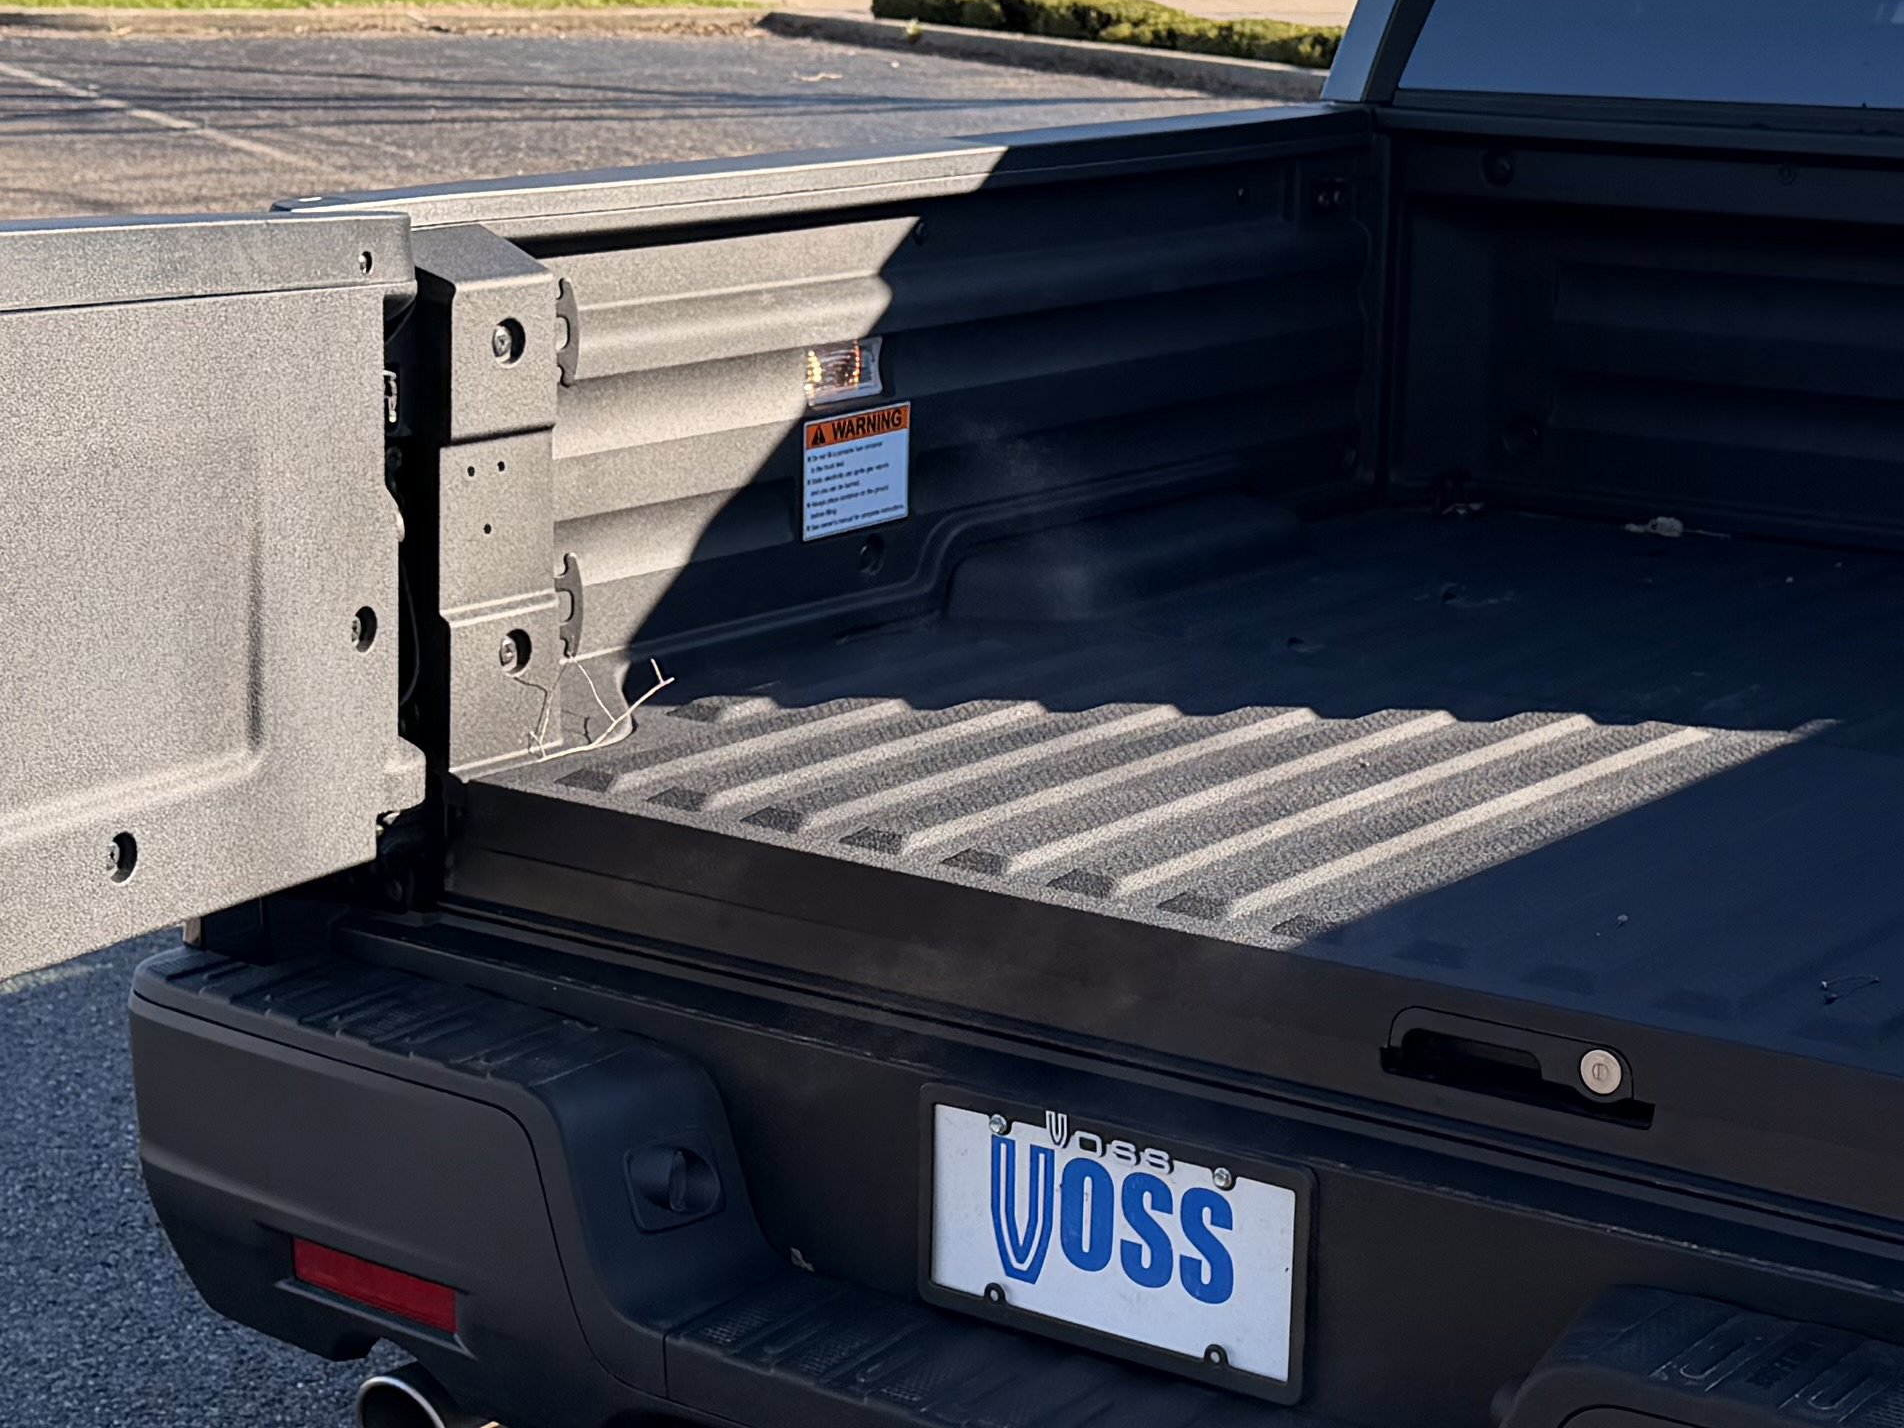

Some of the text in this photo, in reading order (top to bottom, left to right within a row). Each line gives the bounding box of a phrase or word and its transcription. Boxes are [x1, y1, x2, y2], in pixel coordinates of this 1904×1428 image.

[831, 410, 902, 441] WARNING
[1046, 1110, 1173, 1174] VOSS
[991, 1134, 1234, 1305] VOSS
